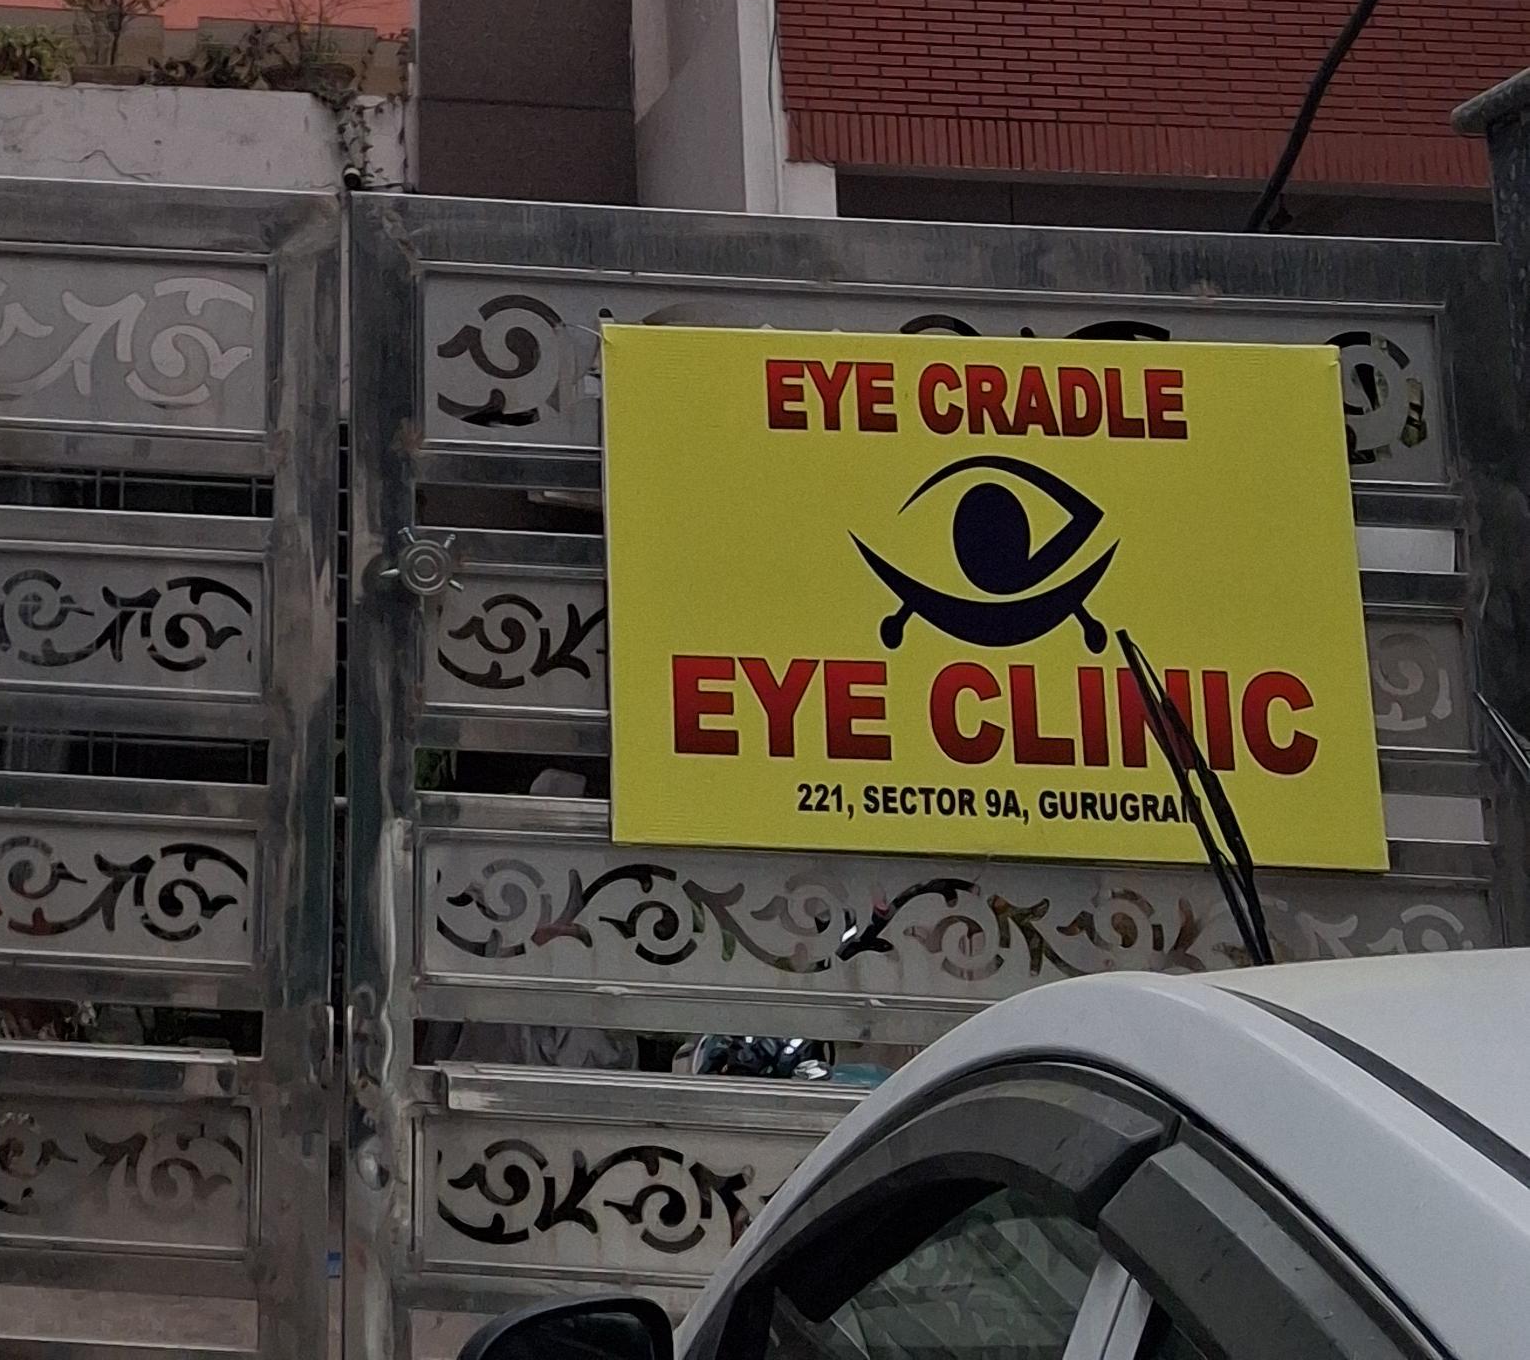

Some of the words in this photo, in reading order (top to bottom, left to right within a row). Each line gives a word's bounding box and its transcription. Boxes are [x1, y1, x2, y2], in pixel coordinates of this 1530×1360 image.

[766, 359, 899, 432] EYE
[918, 363, 1189, 440] CRADLE
[672, 655, 893, 761] EYE
[930, 661, 1319, 776] CLINIC
[797, 783, 855, 820] 221,
[863, 785, 978, 817] SECTOR
[984, 788, 1030, 826] 9A,
